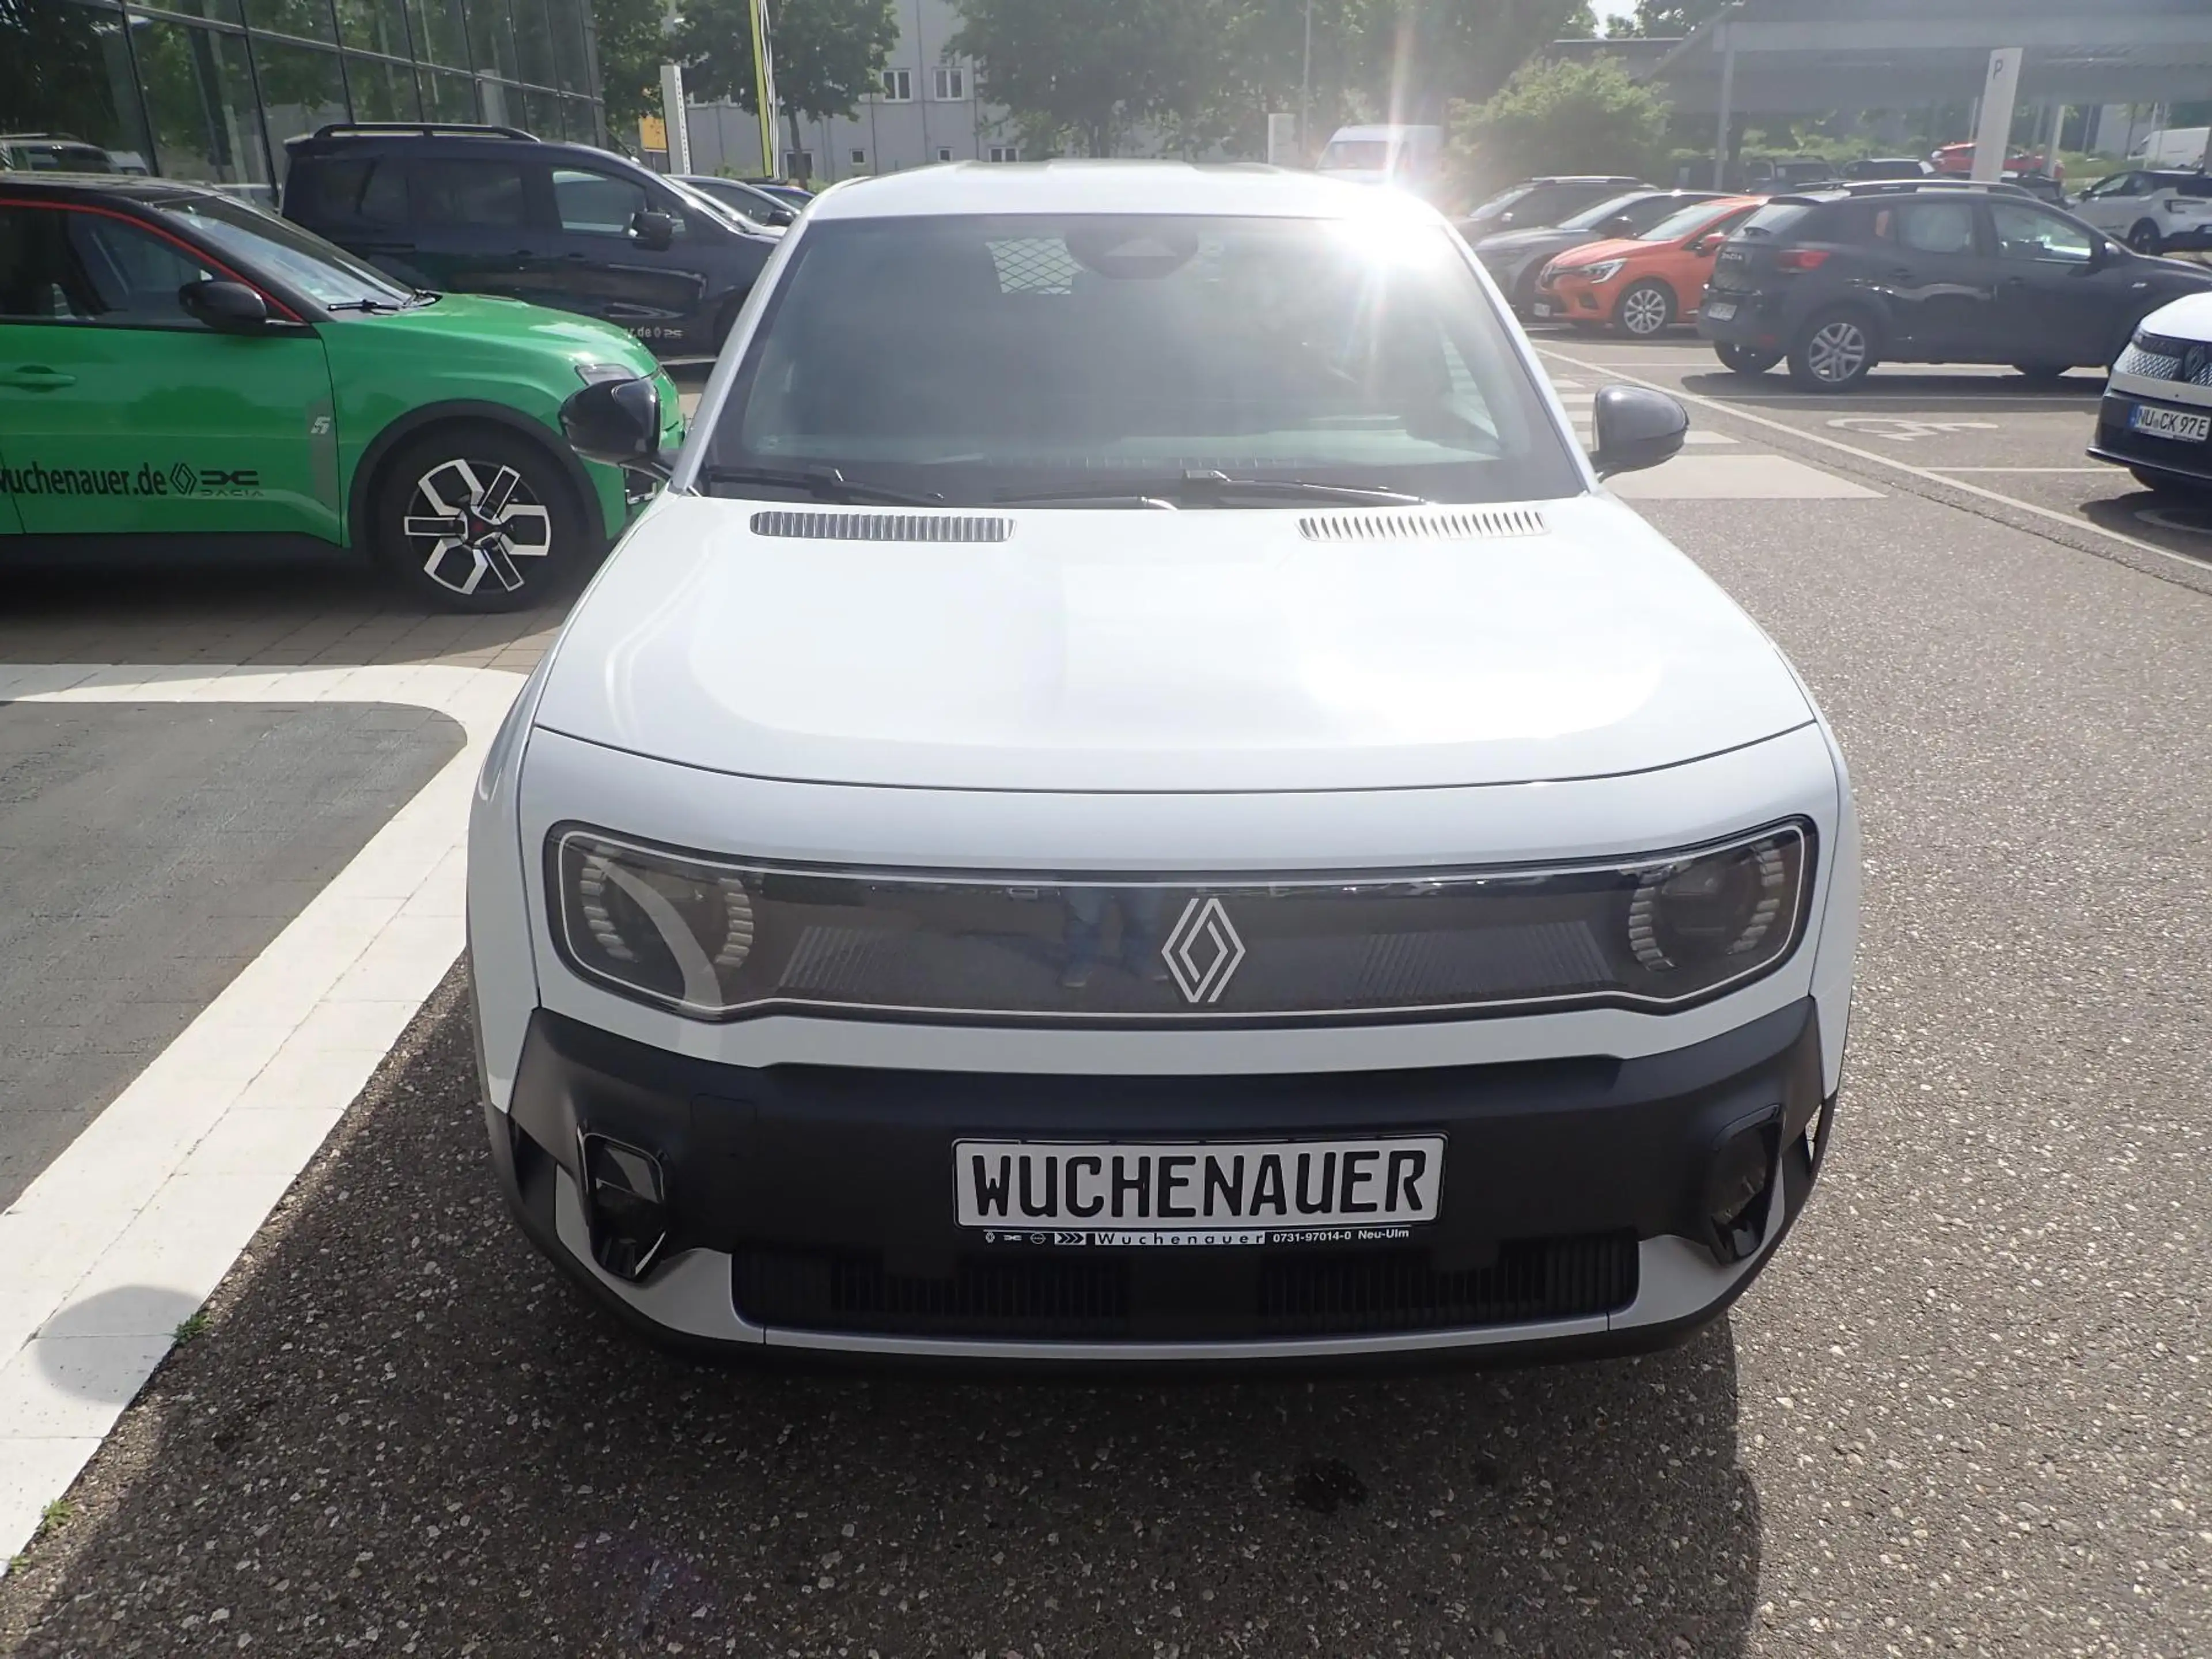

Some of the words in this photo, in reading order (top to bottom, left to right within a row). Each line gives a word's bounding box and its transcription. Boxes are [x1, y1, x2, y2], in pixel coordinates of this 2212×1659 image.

[1993, 59, 2003, 80] P
[2137, 408, 2156, 427] NU
[2160, 412, 2180, 432] CK
[2180, 416, 2207, 437] 97E
[972, 1150, 1427, 1218] WUCHENAUER
[1098, 1232, 1264, 1245] Wuchenauer
[1272, 1230, 1352, 1243] 0731-97014-0
[1357, 1228, 1410, 1240] Neu-Ulm
